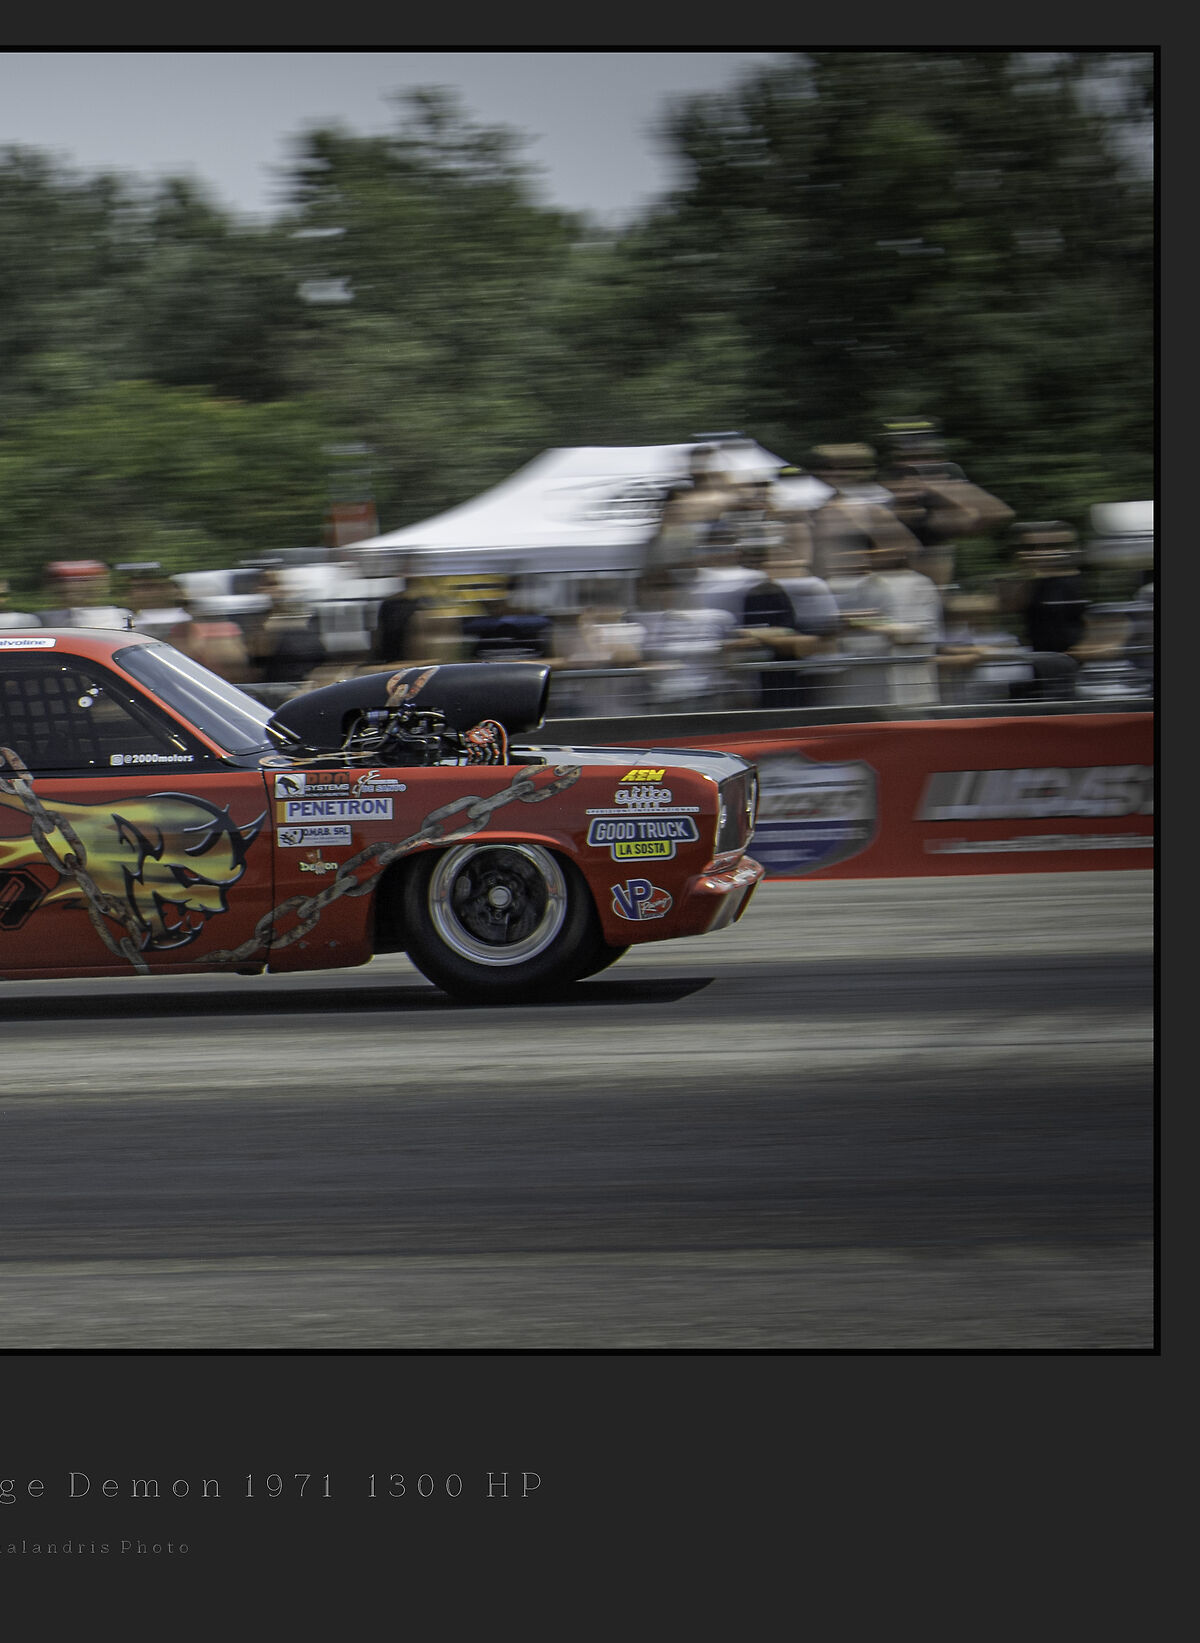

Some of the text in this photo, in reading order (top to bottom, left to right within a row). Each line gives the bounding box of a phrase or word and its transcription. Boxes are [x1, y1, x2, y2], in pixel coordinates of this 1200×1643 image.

[124, 753, 194, 764] @2000motors
[620, 769, 666, 782] AEM
[304, 783, 350, 792] SYSTEMS
[288, 799, 388, 817] PENETRON
[333, 826, 350, 835] SRL
[596, 822, 689, 841] GOOD TRUCK
[620, 843, 666, 855] LA SOSTA
[610, 878, 653, 920] VP
